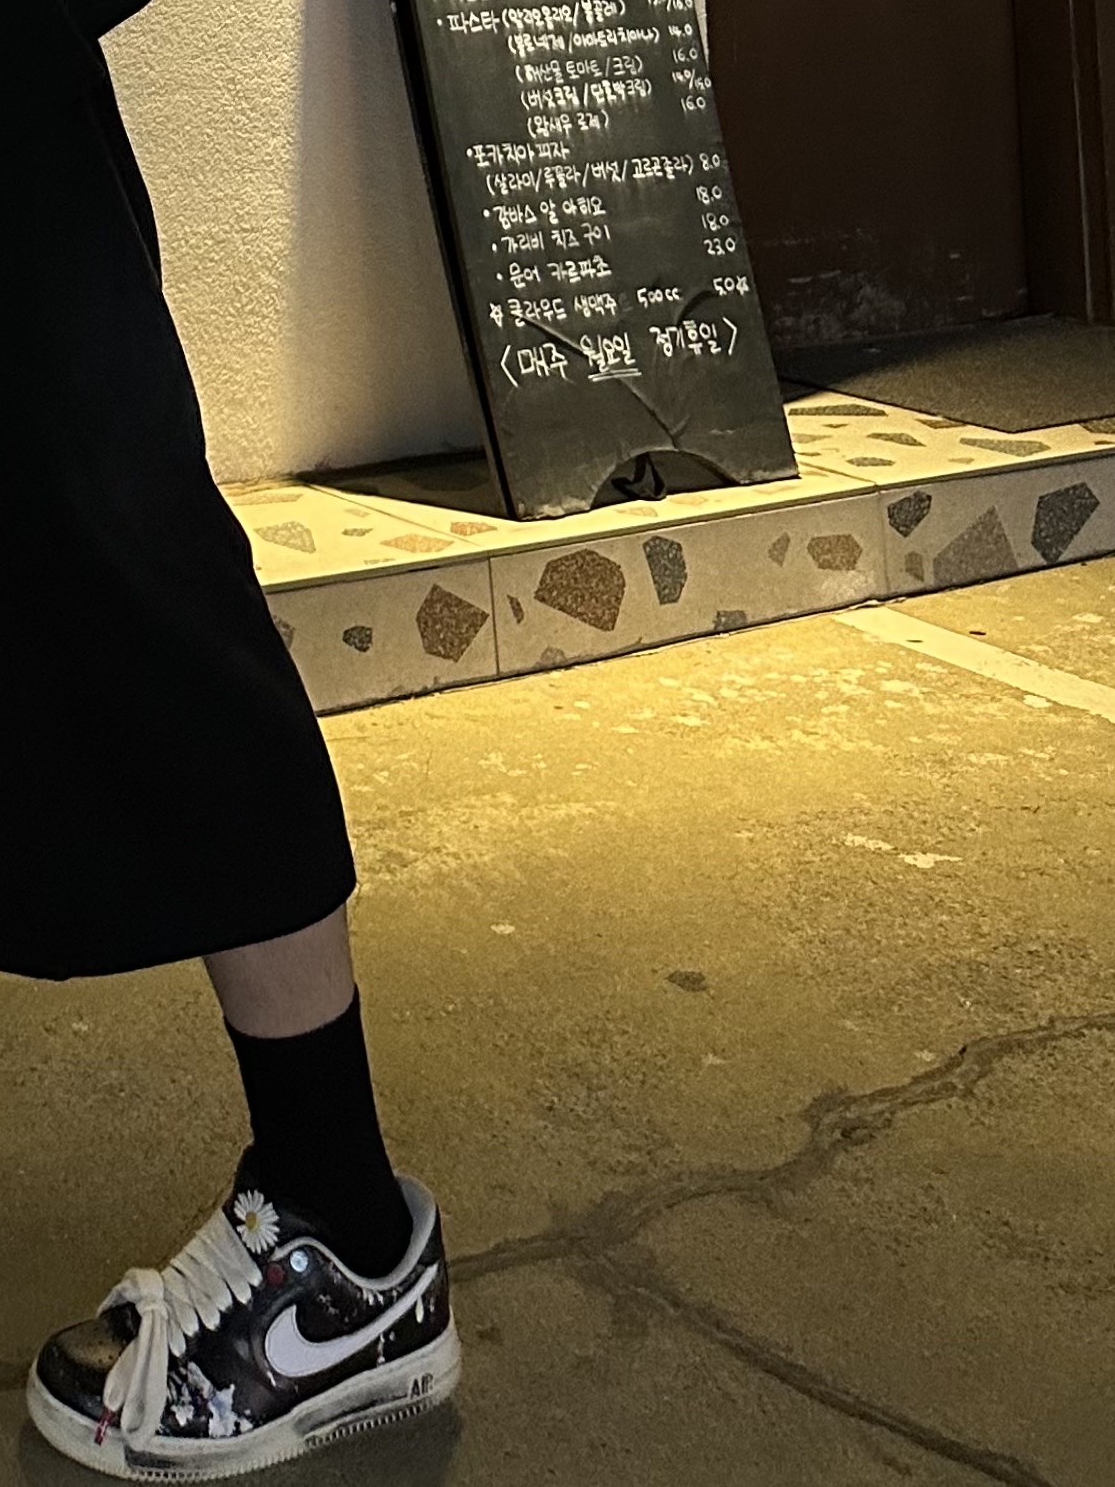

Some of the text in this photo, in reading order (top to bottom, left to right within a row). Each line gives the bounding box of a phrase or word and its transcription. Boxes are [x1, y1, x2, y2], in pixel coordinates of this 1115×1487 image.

[672, 47, 698, 64] 16.0
[699, 152, 721, 172] 8.0
[492, 203, 538, 230] 감바스
[696, 184, 723, 205] 18.0
[501, 230, 545, 254] 가리비
[551, 228, 580, 250] 치즈
[581, 222, 611, 246] 구이
[547, 254, 612, 283] 카르파초
[507, 297, 567, 327] 클라우드
[574, 293, 617, 318] 생맥주
[580, 332, 636, 373] 월요일
